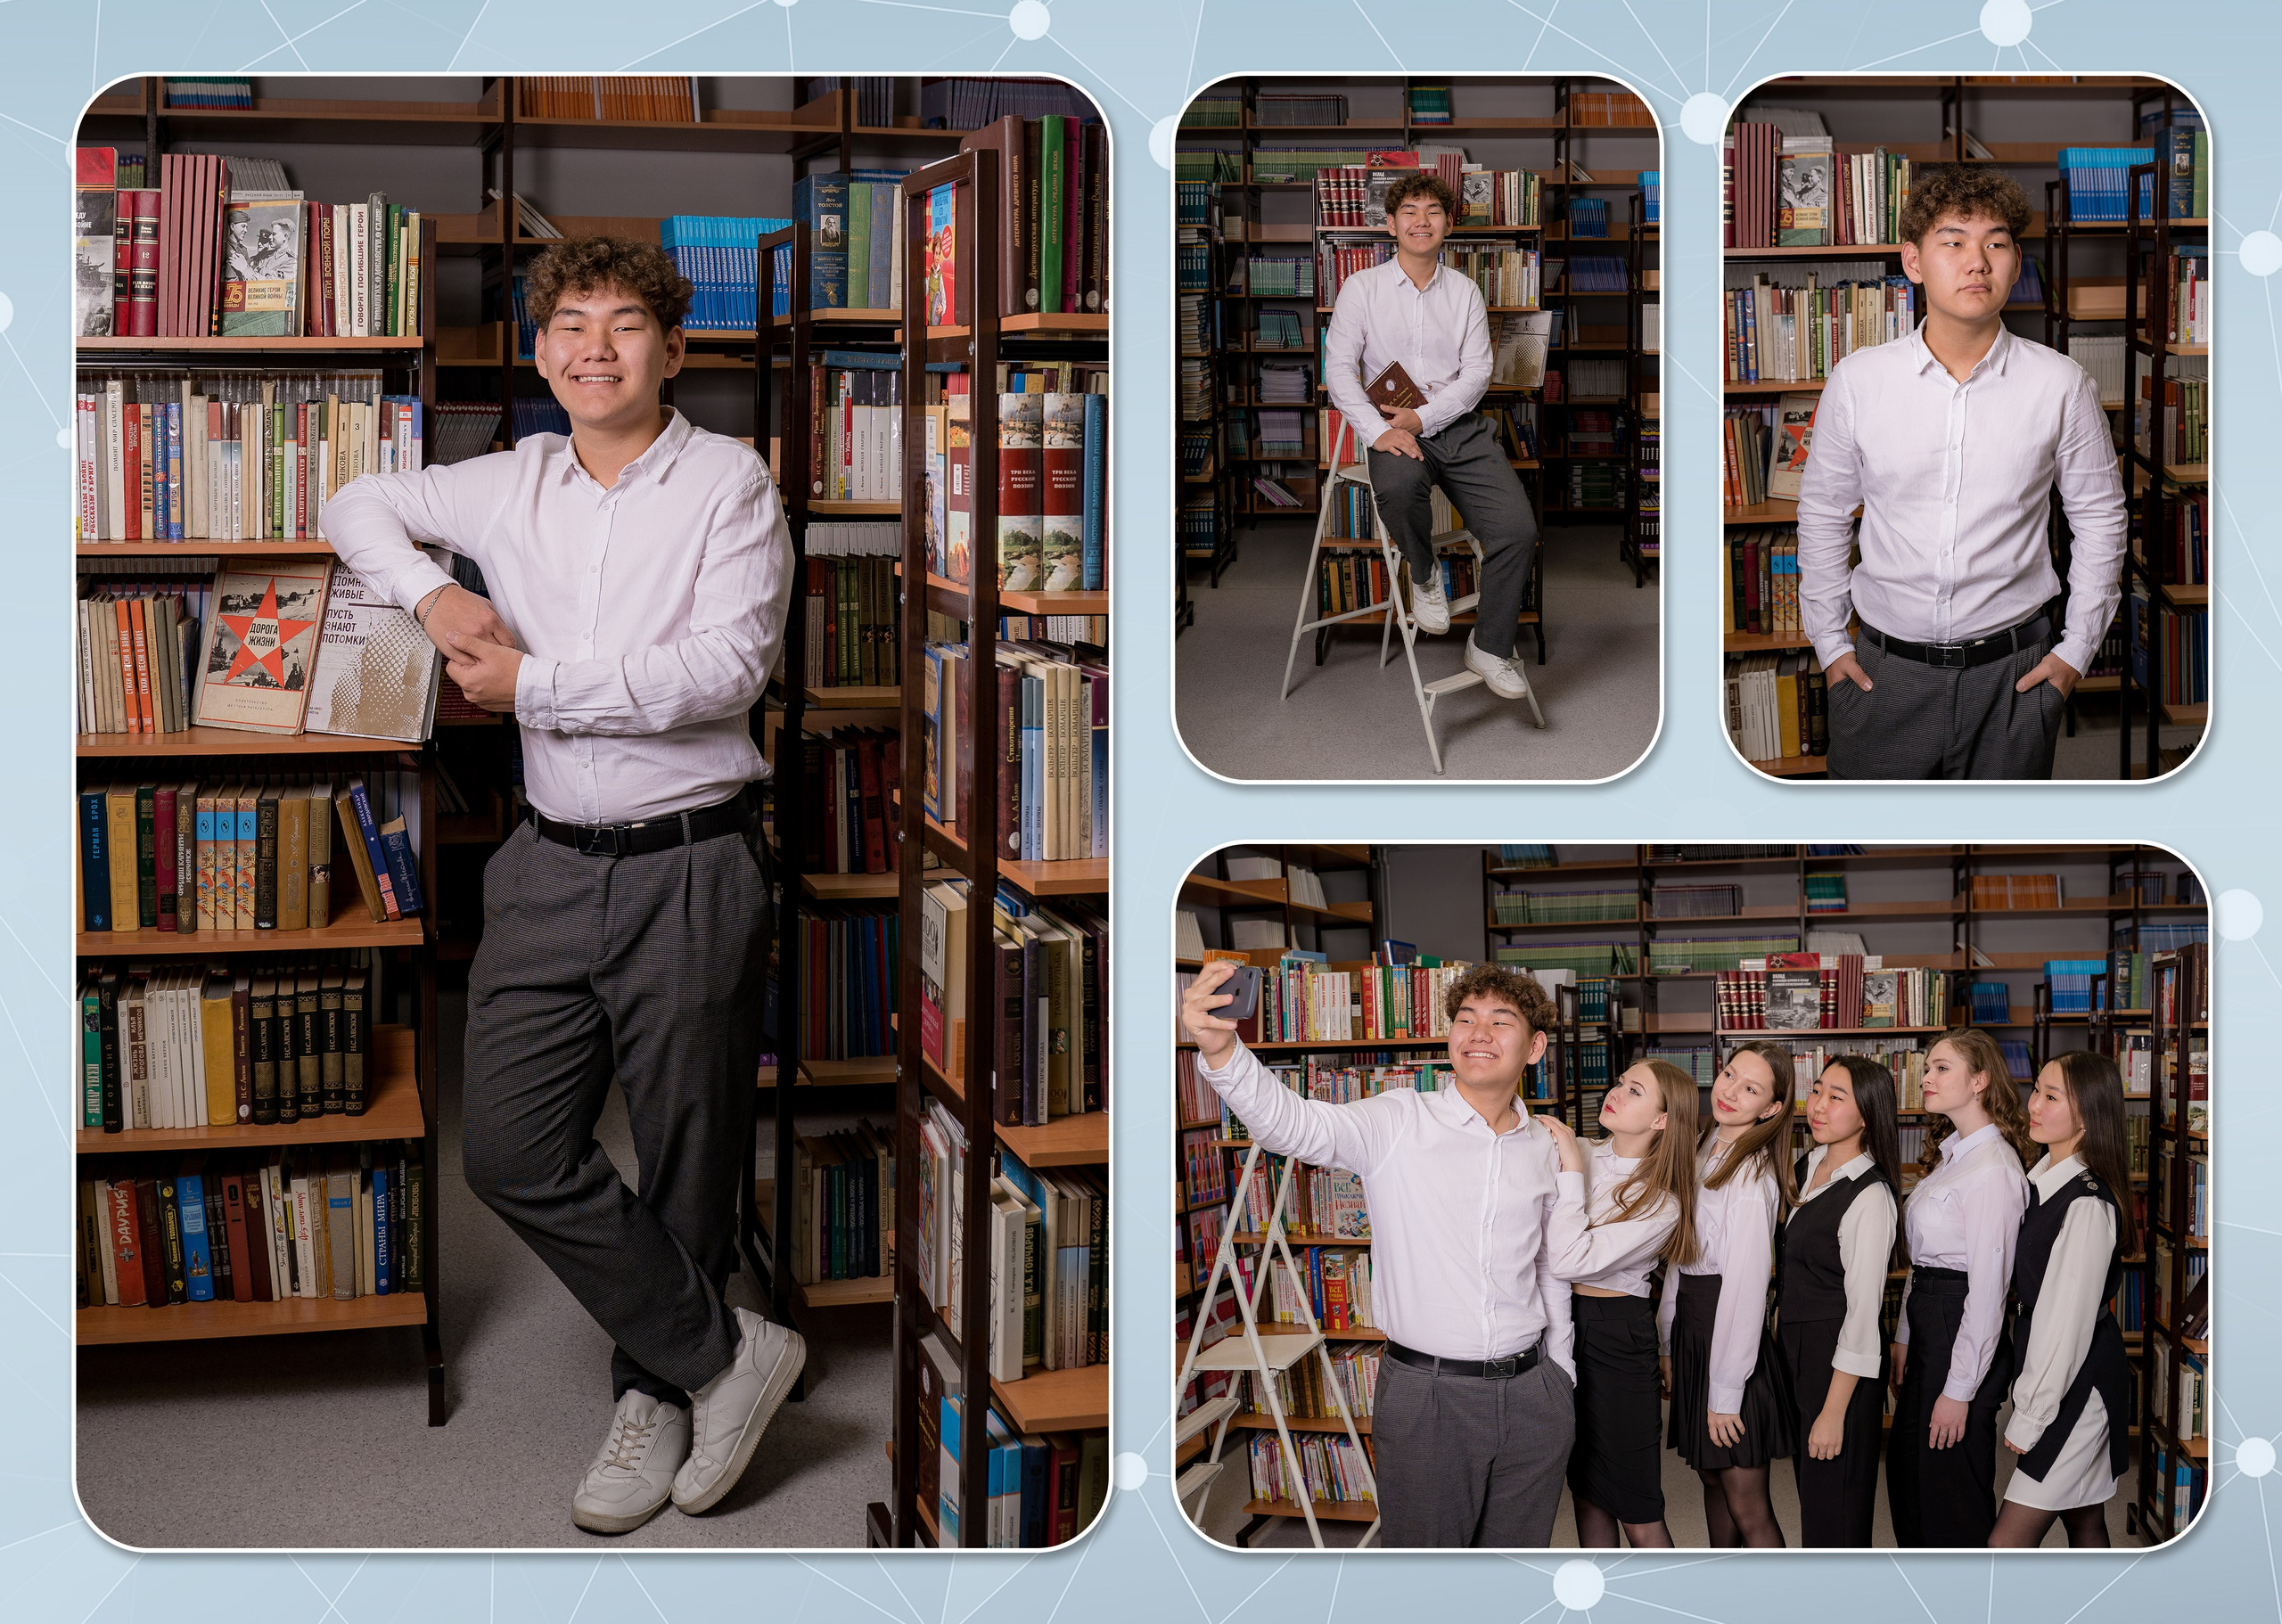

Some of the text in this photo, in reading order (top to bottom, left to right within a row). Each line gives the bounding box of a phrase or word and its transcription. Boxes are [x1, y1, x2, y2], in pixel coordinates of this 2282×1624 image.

[1091, 173, 1099, 201] России
[1029, 179, 1038, 280] Древнерусская литература
[323, 217, 333, 299] ДЕТИ ВОЕННОЙ ПОРЫ
[1089, 235, 1099, 282] Литература
[408, 307, 416, 326] МУЗЫ
[1091, 406, 1101, 544] ИСТОРИЯ ЗАРУБЕЖНОЙ ЛИТЕРАТУРЫ
[330, 588, 365, 600] ЖИВЫЕ
[249, 622, 279, 636] ДОРОГА
[324, 620, 357, 632] ЗНАЮТ
[326, 609, 354, 619] ПУСТЬ
[135, 629, 144, 647] ВОЙНЕ
[248, 637, 276, 647] ЖИЗНИ
[322, 634, 365, 645] ПОТОМКИ
[138, 654, 146, 672] ПЕСНИ
[140, 677, 149, 694] СТИХИ
[1006, 706, 1014, 763] Стихотворения
[1081, 720, 1089, 773] БОМАРШЕ
[354, 794, 367, 827] АЛЕКСАНДР
[360, 792, 373, 825] ТВАРДОВСКИЙ
[92, 827, 100, 859] ГЕРМАН
[177, 866, 185, 897] ФРИДЕШ
[105, 1044, 115, 1107] ГОРАЦИЙ
[137, 1045, 145, 1079] ПИРОГОВА
[86, 1063, 101, 1114] ЯЛМАР ТЕСЕН
[140, 1085, 148, 1125] МОГИЛЕВСКИЙ
[1334, 1182, 1351, 1193] ВСЕ
[377, 1193, 386, 1266] СТРАНЫ МИРА
[1025, 1227, 1034, 1292] И.А. ГОНЧАРОВ
